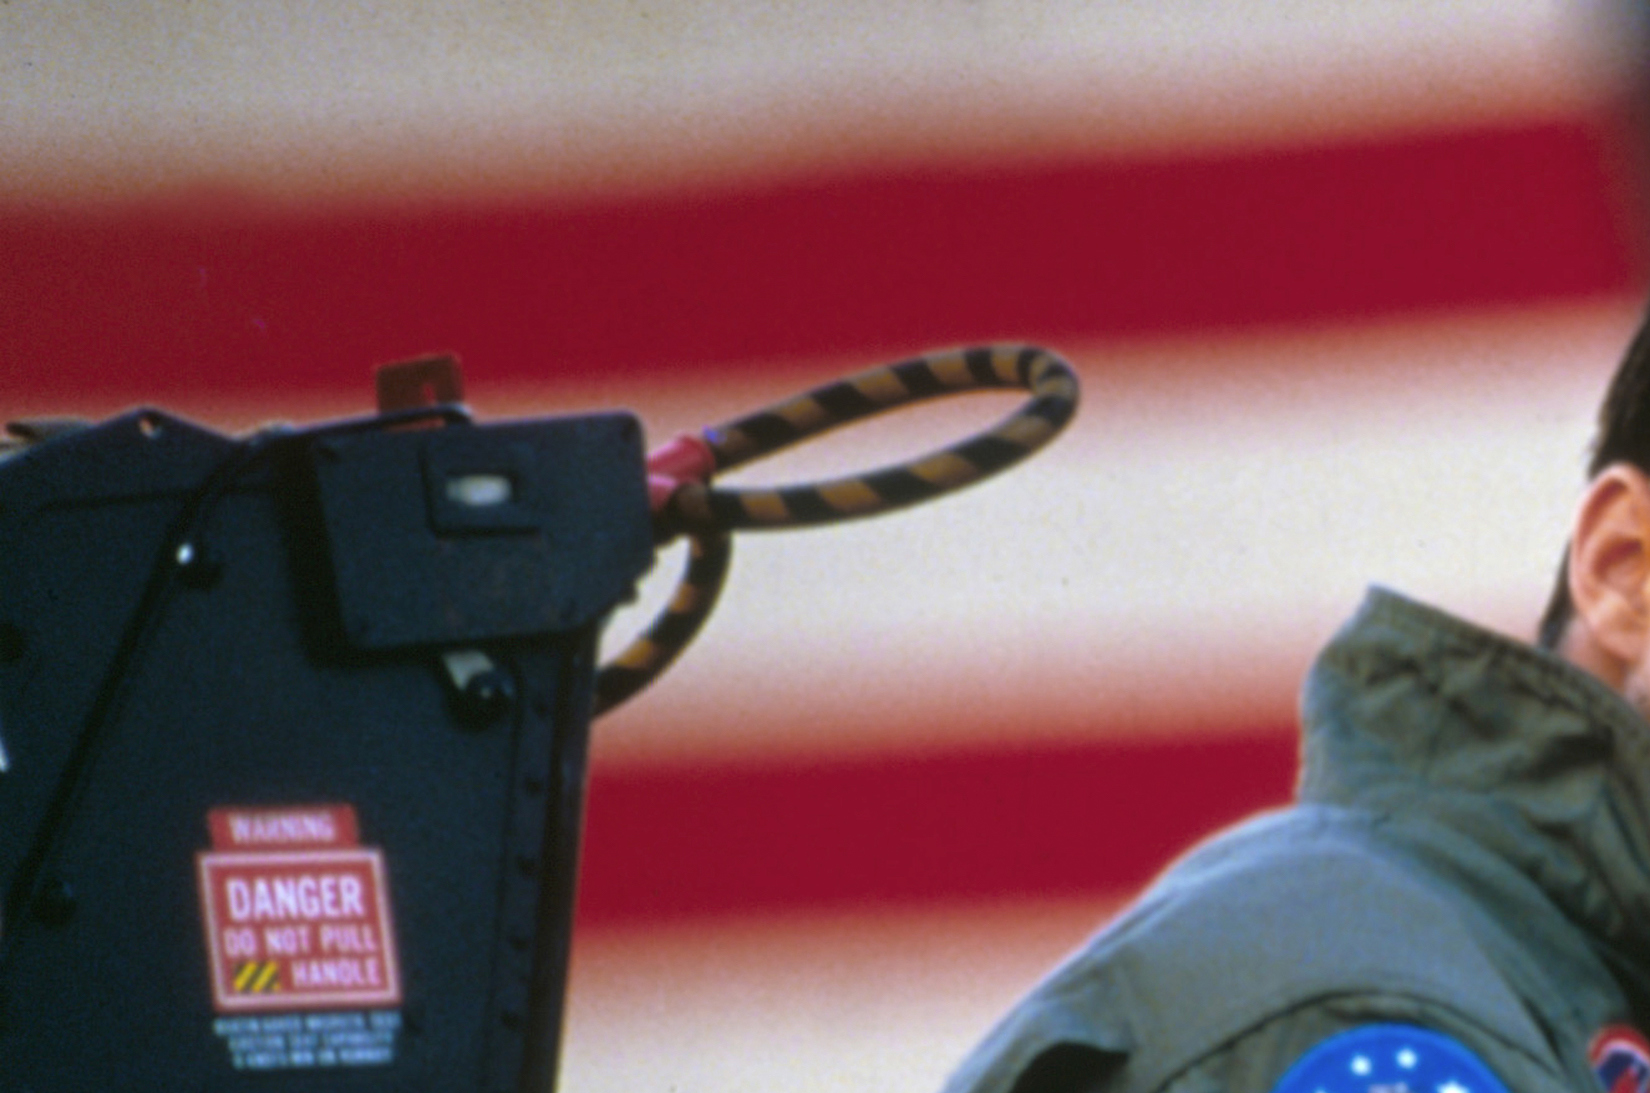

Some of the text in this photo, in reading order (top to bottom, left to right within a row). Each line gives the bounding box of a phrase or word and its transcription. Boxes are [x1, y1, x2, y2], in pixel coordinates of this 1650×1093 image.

[228, 810, 337, 844] WARNING
[225, 875, 364, 922] DANGER
[223, 924, 377, 958] DO NOT PULL
[291, 958, 381, 989] HANDLE
